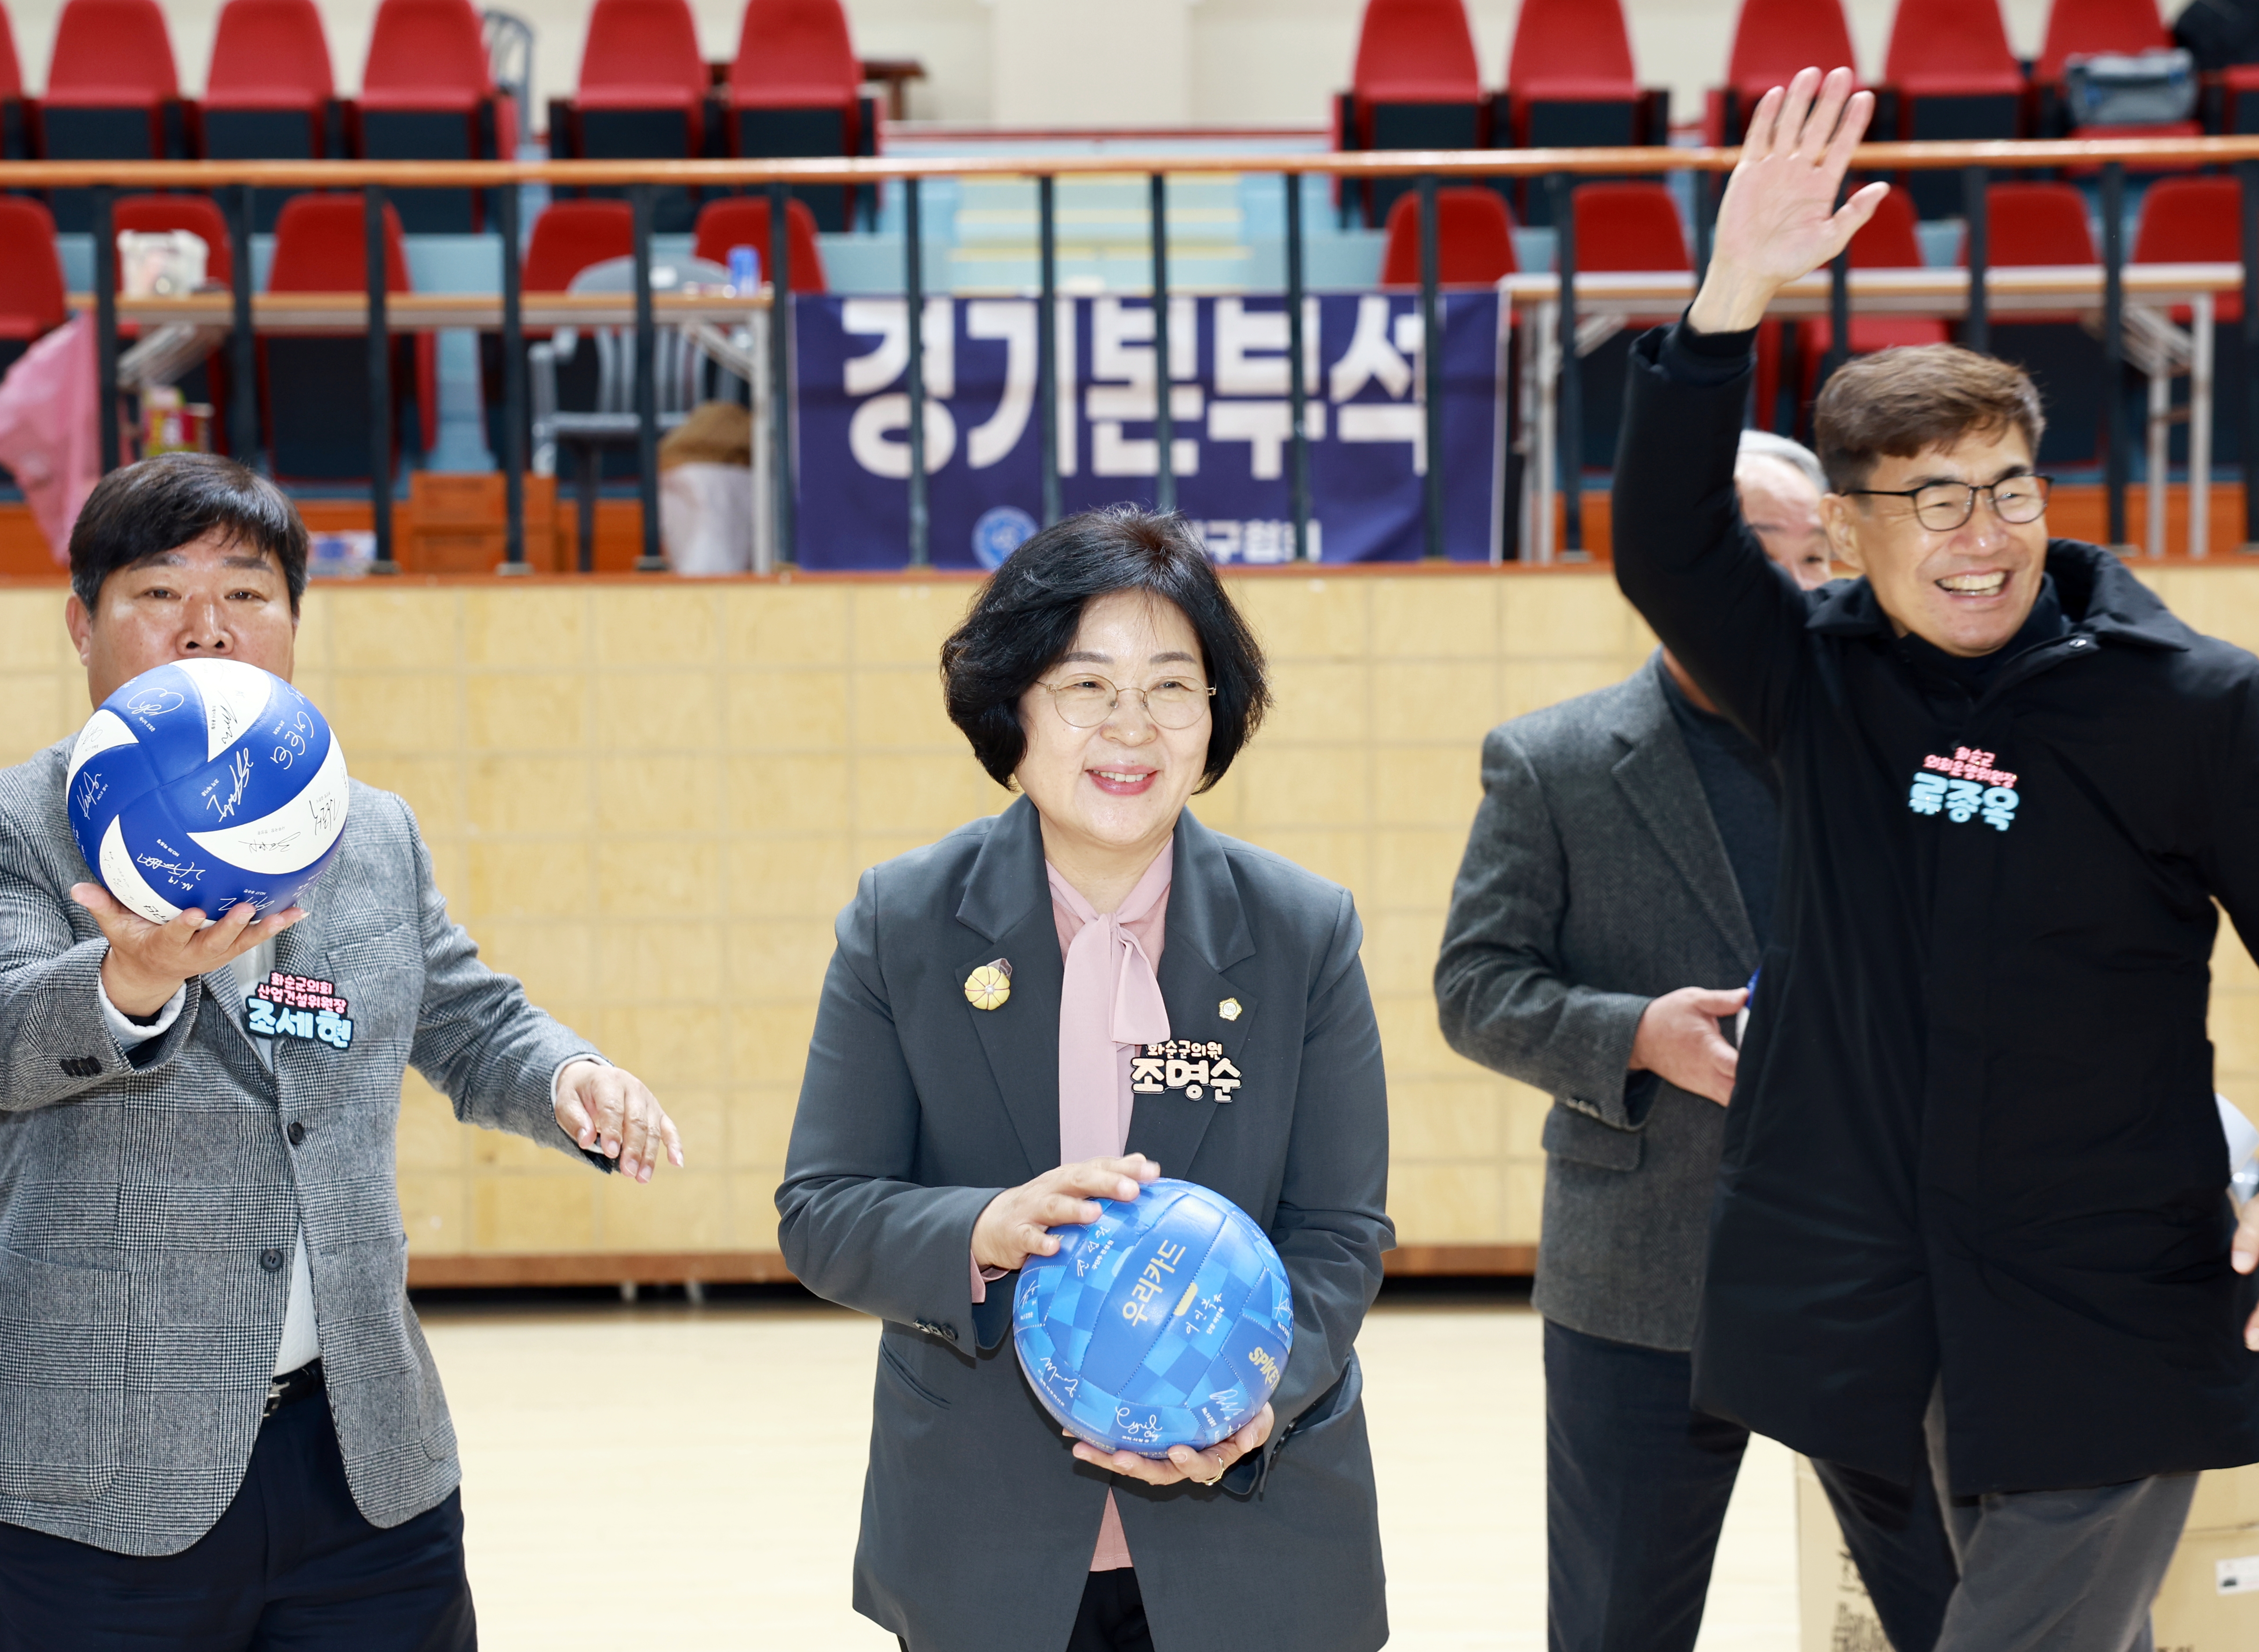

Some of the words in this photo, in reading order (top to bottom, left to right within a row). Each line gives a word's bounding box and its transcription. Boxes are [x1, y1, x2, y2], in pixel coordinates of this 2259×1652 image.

[1189, 518, 1322, 564] 구협회
[257, 983, 347, 1014] 산업건설위원장
[271, 972, 333, 995] 화순군의회
[248, 998, 352, 1048] 조세현
[1147, 1040, 1223, 1061] 화순군의원
[1131, 1057, 1242, 1102] 조명순
[1092, 1255, 1102, 1270] 구단주
[1100, 1240, 1114, 1255] 진성원
[1122, 1239, 1186, 1327] 우리카드
[1206, 1323, 1215, 1334] 단장
[1115, 1407, 1163, 1434] Cyril
